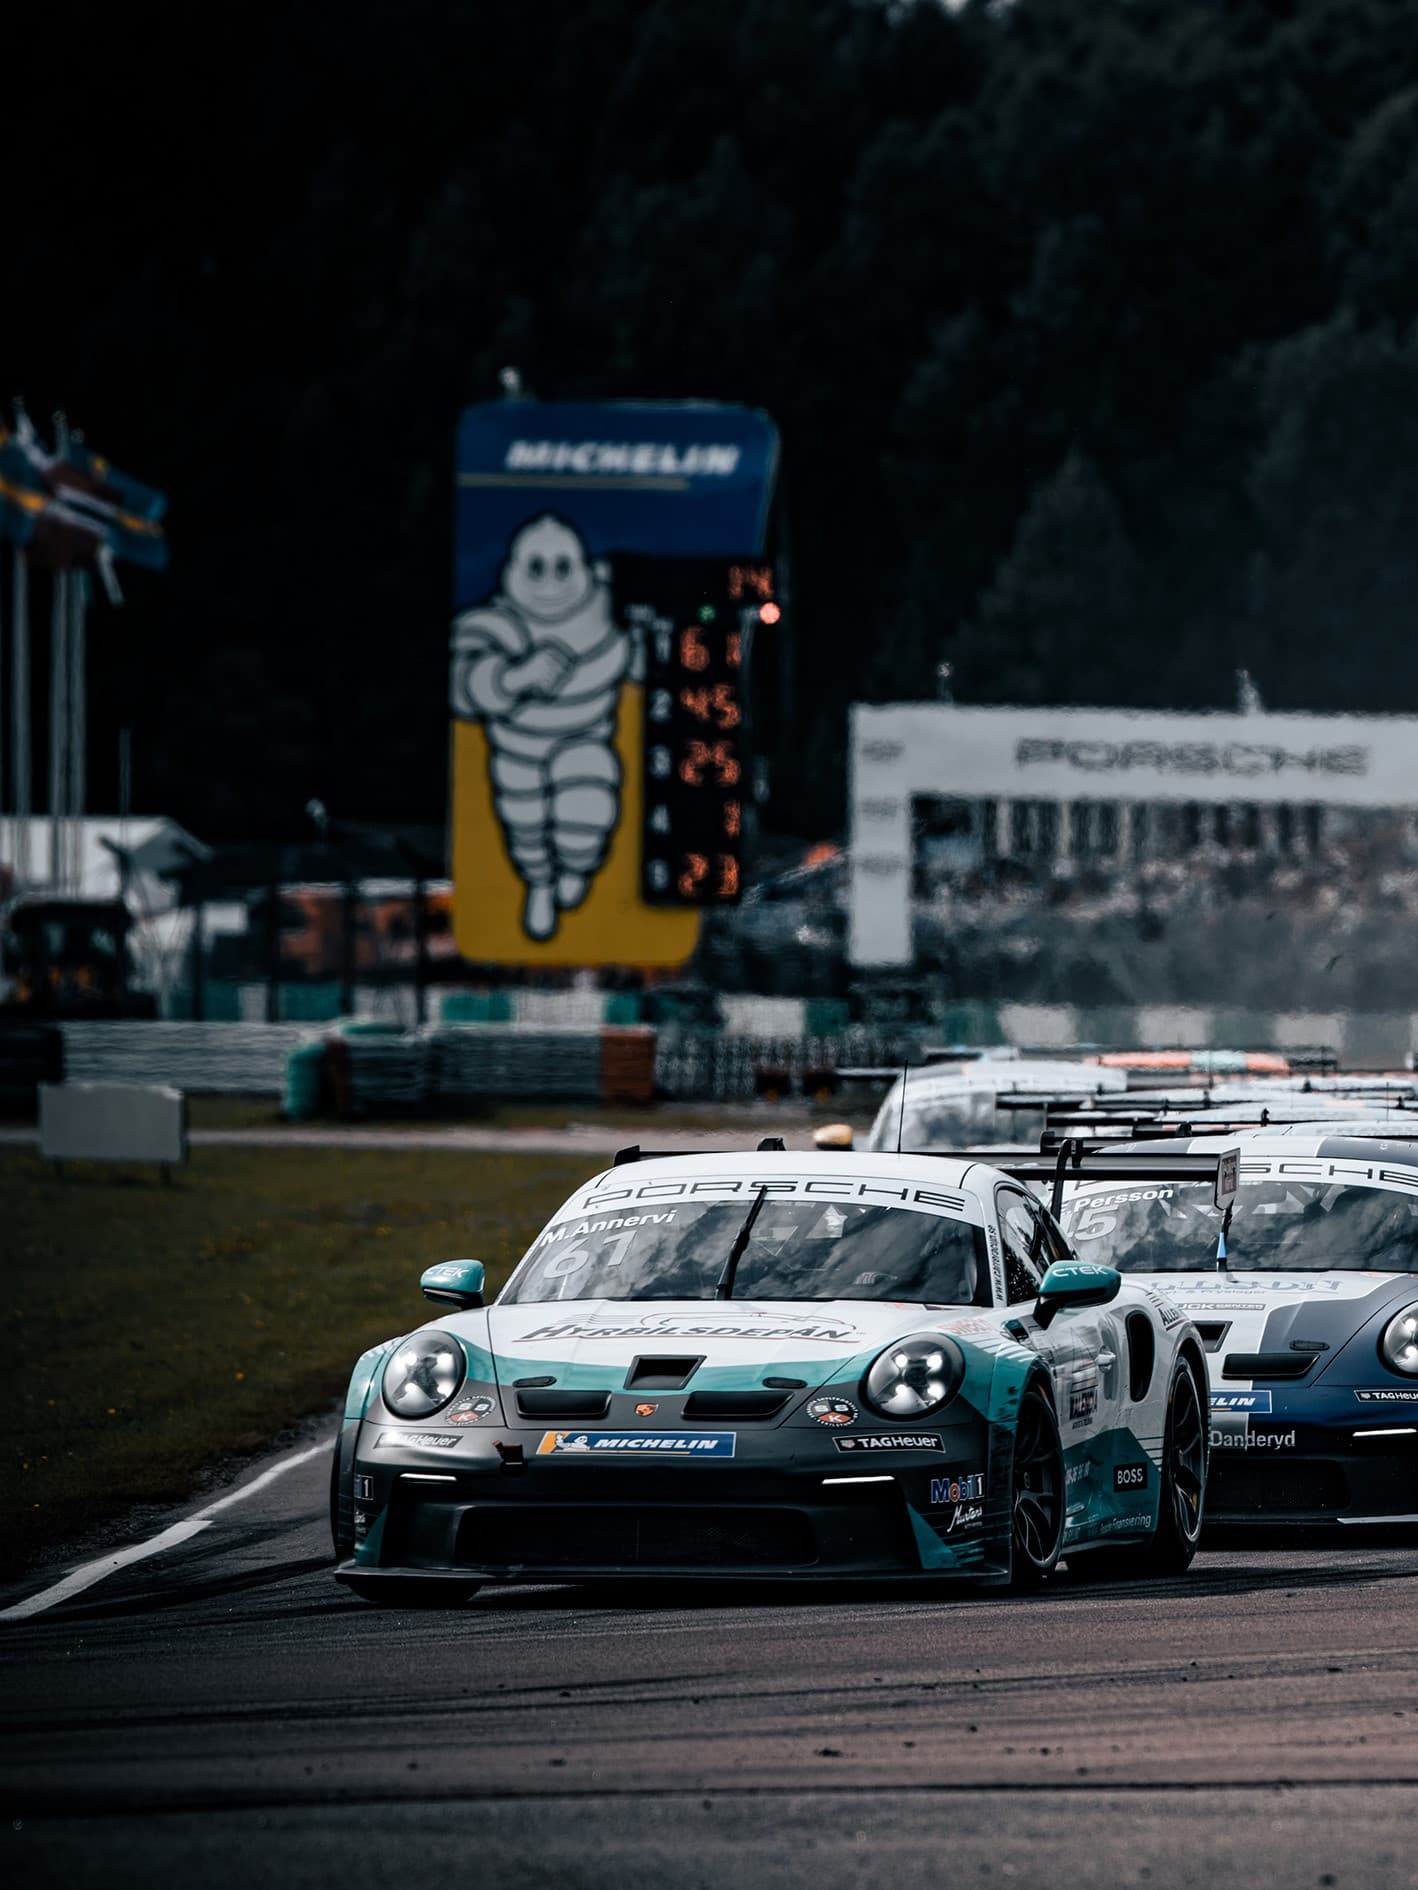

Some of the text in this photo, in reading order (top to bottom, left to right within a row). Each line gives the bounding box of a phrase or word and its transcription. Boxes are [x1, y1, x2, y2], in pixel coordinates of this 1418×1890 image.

[505, 440, 741, 476] MICHELIN
[1016, 738, 1368, 775] PORSCHE
[583, 1180, 965, 1212] PORSCHE
[540, 1210, 677, 1248] M.Annervi
[543, 1230, 637, 1280] 61
[1051, 1265, 1108, 1278] CTEK
[594, 1439, 719, 1450] MICHELIN
[1211, 1430, 1296, 1450] Danderyd
[930, 1474, 976, 1504] Mobil
[1117, 1468, 1144, 1485] BOSS
